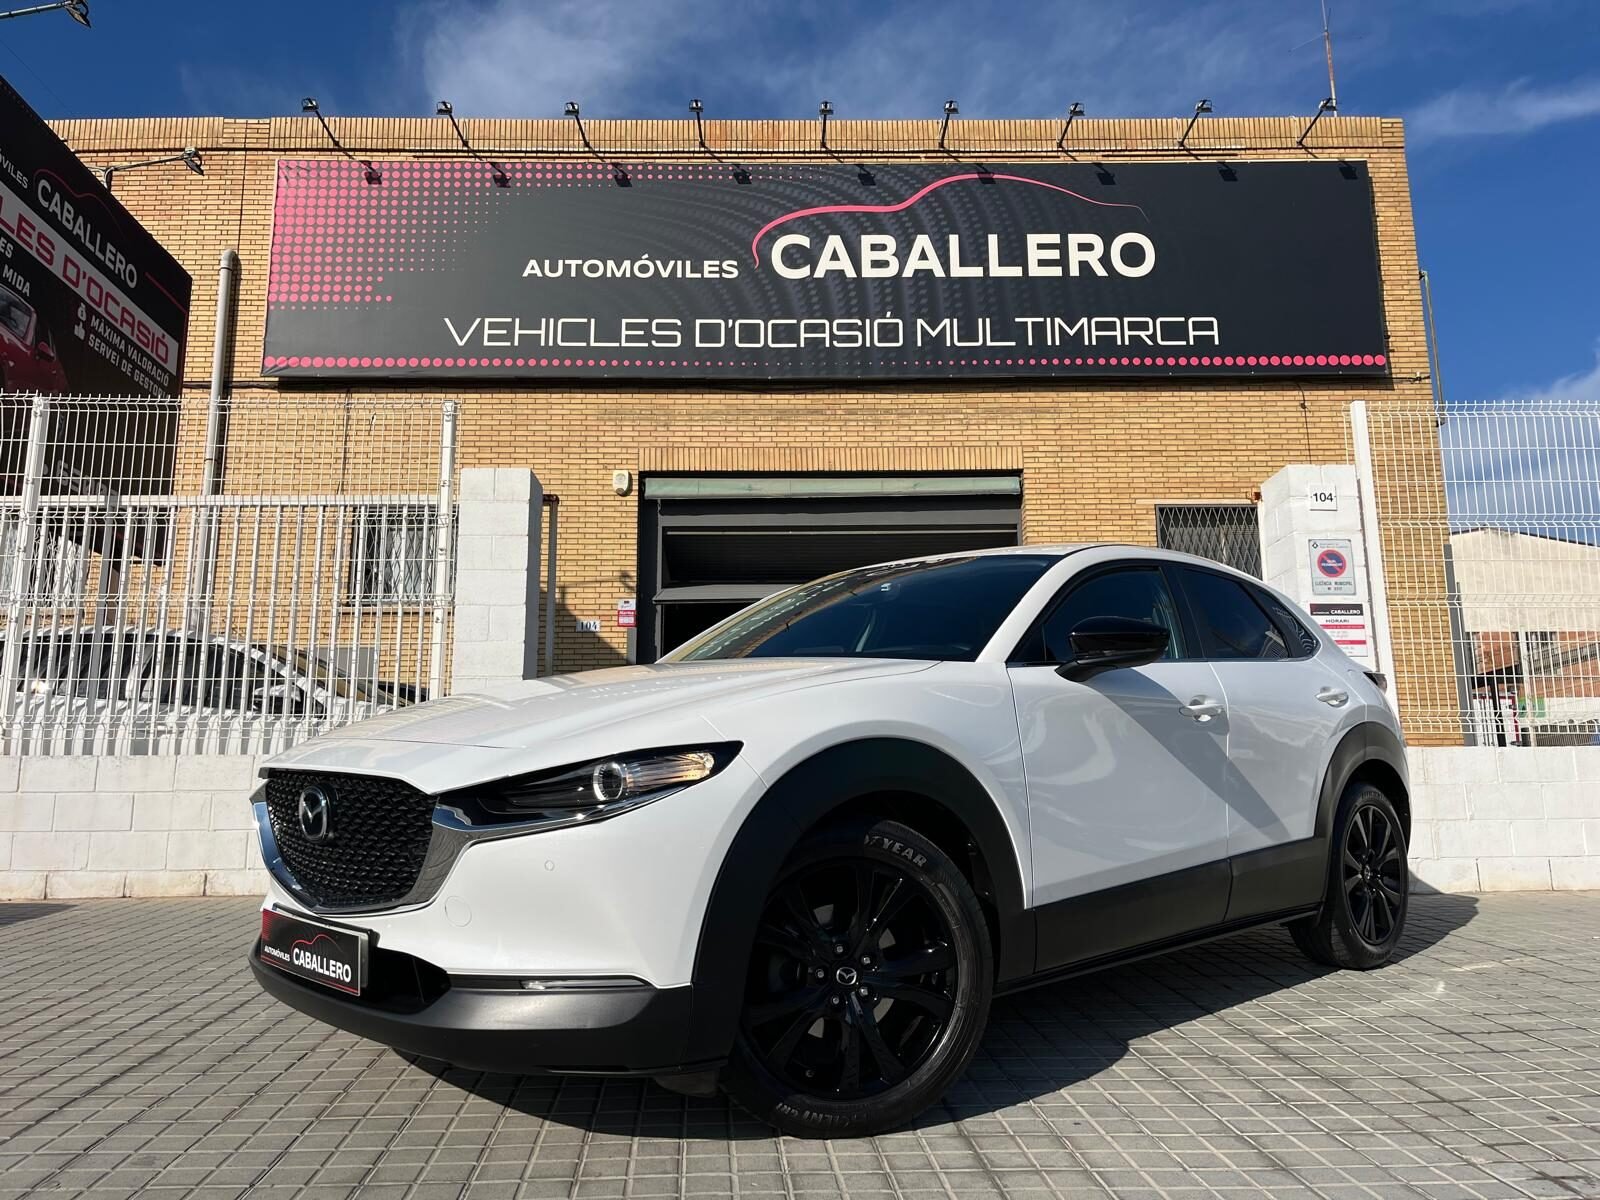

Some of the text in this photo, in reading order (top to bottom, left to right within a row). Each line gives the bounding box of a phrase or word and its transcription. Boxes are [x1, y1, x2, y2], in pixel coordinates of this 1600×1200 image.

[38, 179, 137, 289] CABALLERO
[522, 232, 1156, 279] AUTOMÓVILES CABALLERO
[3, 263, 30, 297] MIDA
[63, 254, 169, 365] D'OCASIÓ
[444, 311, 1220, 348] VEHICLES D'OCASIÓ MULTIMARCA
[88, 334, 120, 367] SERVEI
[121, 359, 133, 376] DE
[128, 344, 169, 386] VALORACIÓ
[1312, 492, 1334, 502] 104
[581, 621, 597, 630] 104
[264, 945, 352, 983] AUTOMÓVILES CABALLERO
